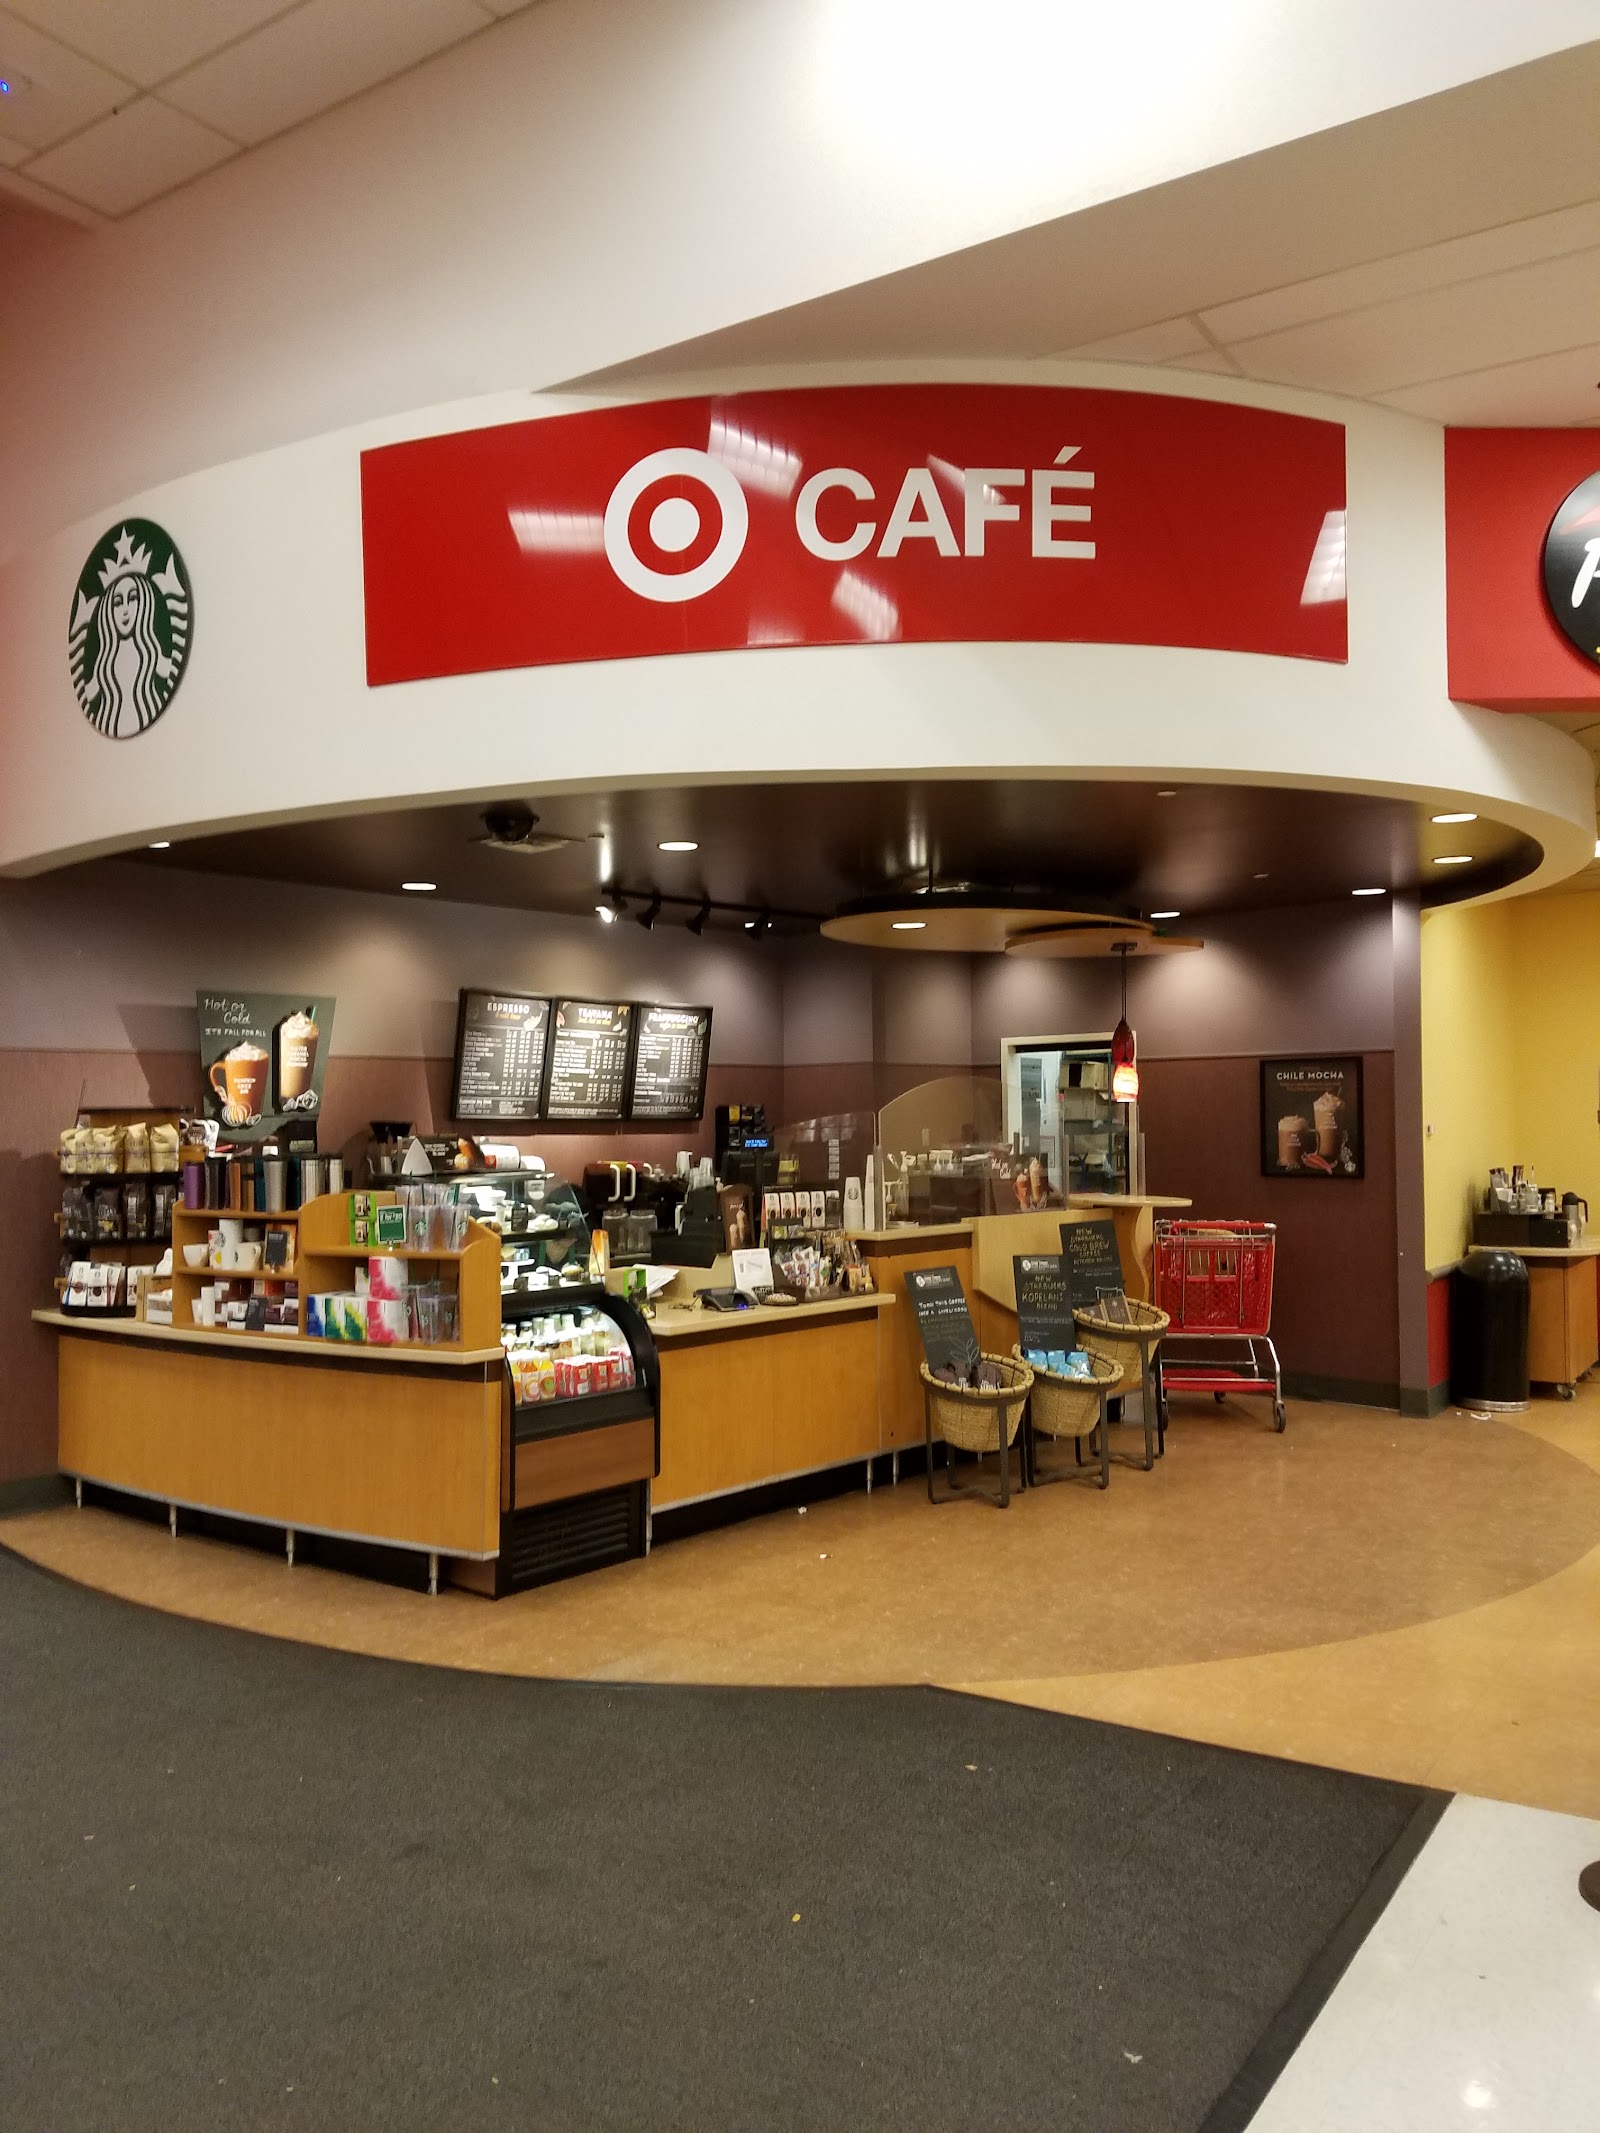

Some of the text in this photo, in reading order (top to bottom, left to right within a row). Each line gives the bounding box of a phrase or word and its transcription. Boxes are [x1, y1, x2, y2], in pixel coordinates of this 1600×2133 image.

[795, 446, 1096, 561] CAFÉ
[204, 998, 228, 1012] Hot
[487, 1002, 530, 1014] ESPRESSO
[223, 1011, 251, 1025] Cold
[1276, 1071, 1344, 1080] CHILE MOCHA
[1076, 1227, 1093, 1236] NEW
[1089, 1239, 1110, 1251] BREW
[1034, 1275, 1052, 1283] NEW
[1022, 1281, 1067, 1292] STARBUCKS
[948, 1297, 966, 1305] COFFEE
